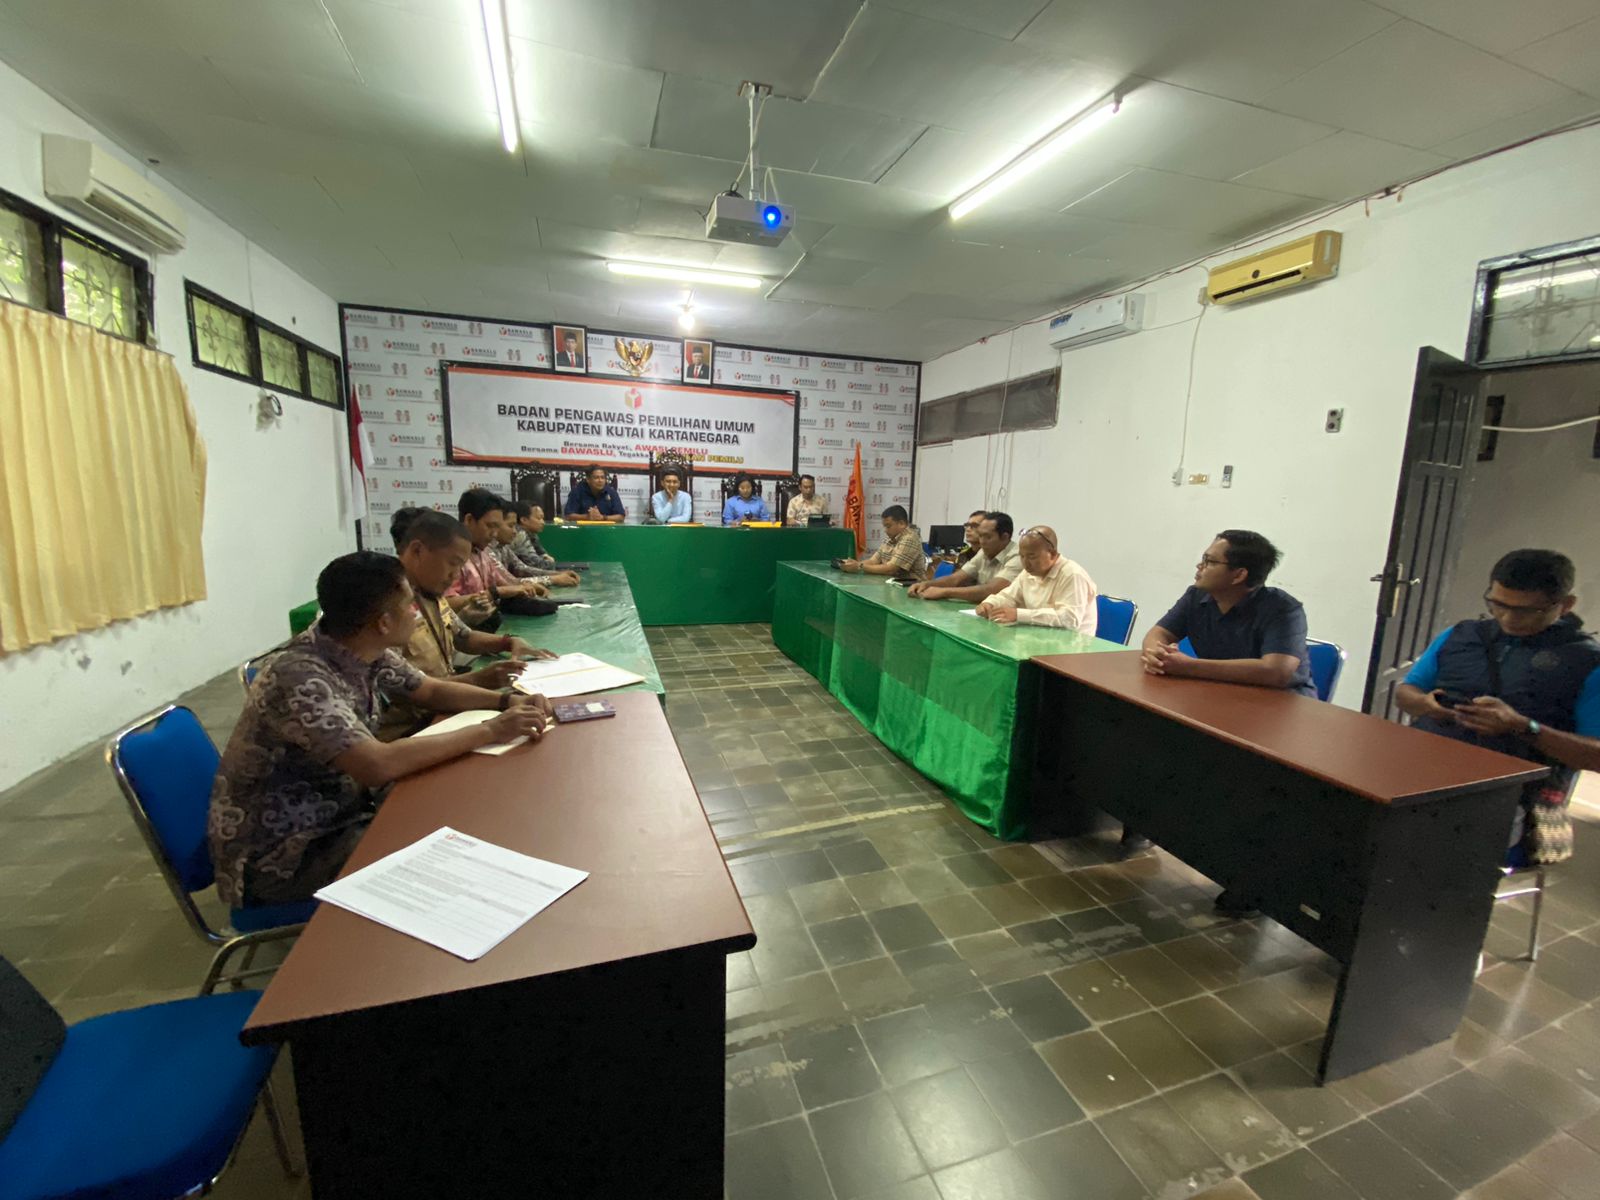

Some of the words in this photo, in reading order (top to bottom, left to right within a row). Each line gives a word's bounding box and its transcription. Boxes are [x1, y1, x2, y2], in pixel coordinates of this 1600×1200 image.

[497, 404, 550, 418] BADAN
[555, 407, 634, 424] PENGAWAS
[638, 414, 711, 430] PEMILIHAN
[715, 420, 755, 433] UMUM
[517, 420, 601, 436] KABUPATEN
[606, 425, 644, 439] KUTAI
[649, 428, 740, 445] KARTANEGARA
[521, 445, 558, 453] Bersama
[561, 447, 617, 458] BAWASLU,
[707, 455, 744, 464] PEMILU
[563, 441, 600, 449] Bersama
